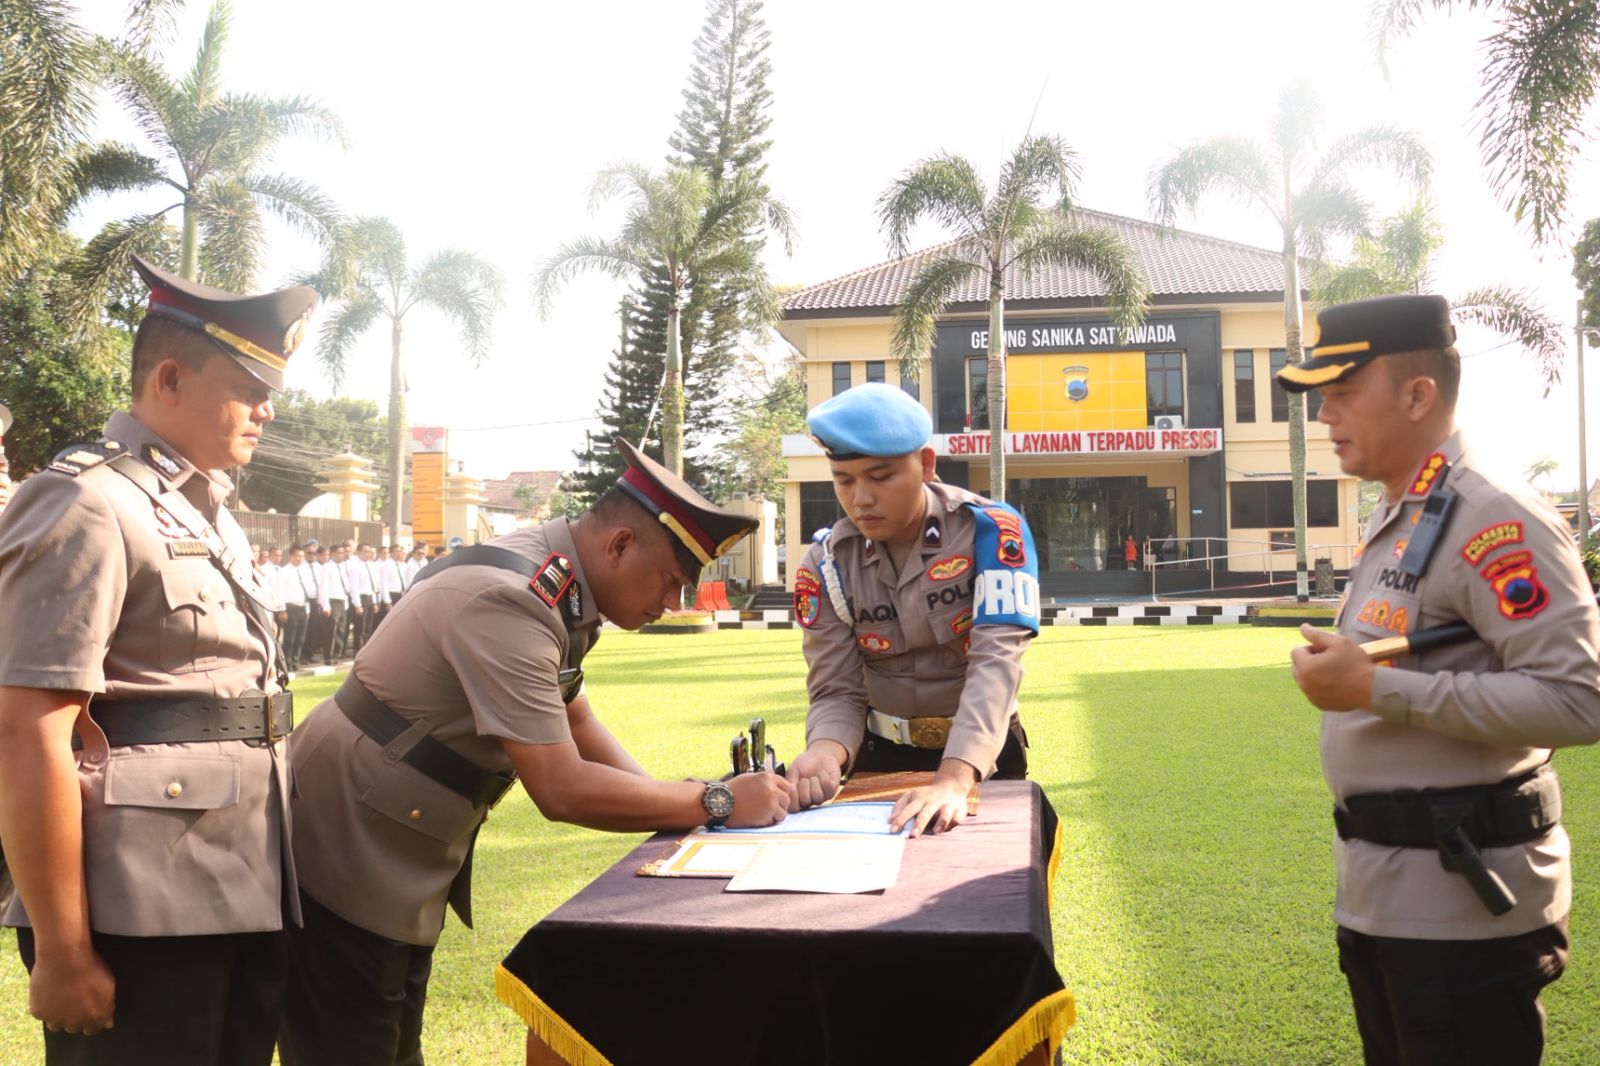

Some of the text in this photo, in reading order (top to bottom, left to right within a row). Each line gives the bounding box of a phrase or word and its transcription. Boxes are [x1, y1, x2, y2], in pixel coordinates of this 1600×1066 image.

[971, 329, 1026, 349] GENG
[1032, 327, 1085, 347] SANIKA
[948, 429, 1217, 454] SENTR LAYANAN TERPADU PRESISI
[1377, 567, 1419, 595] POLRI
[972, 568, 1041, 622] PRO
